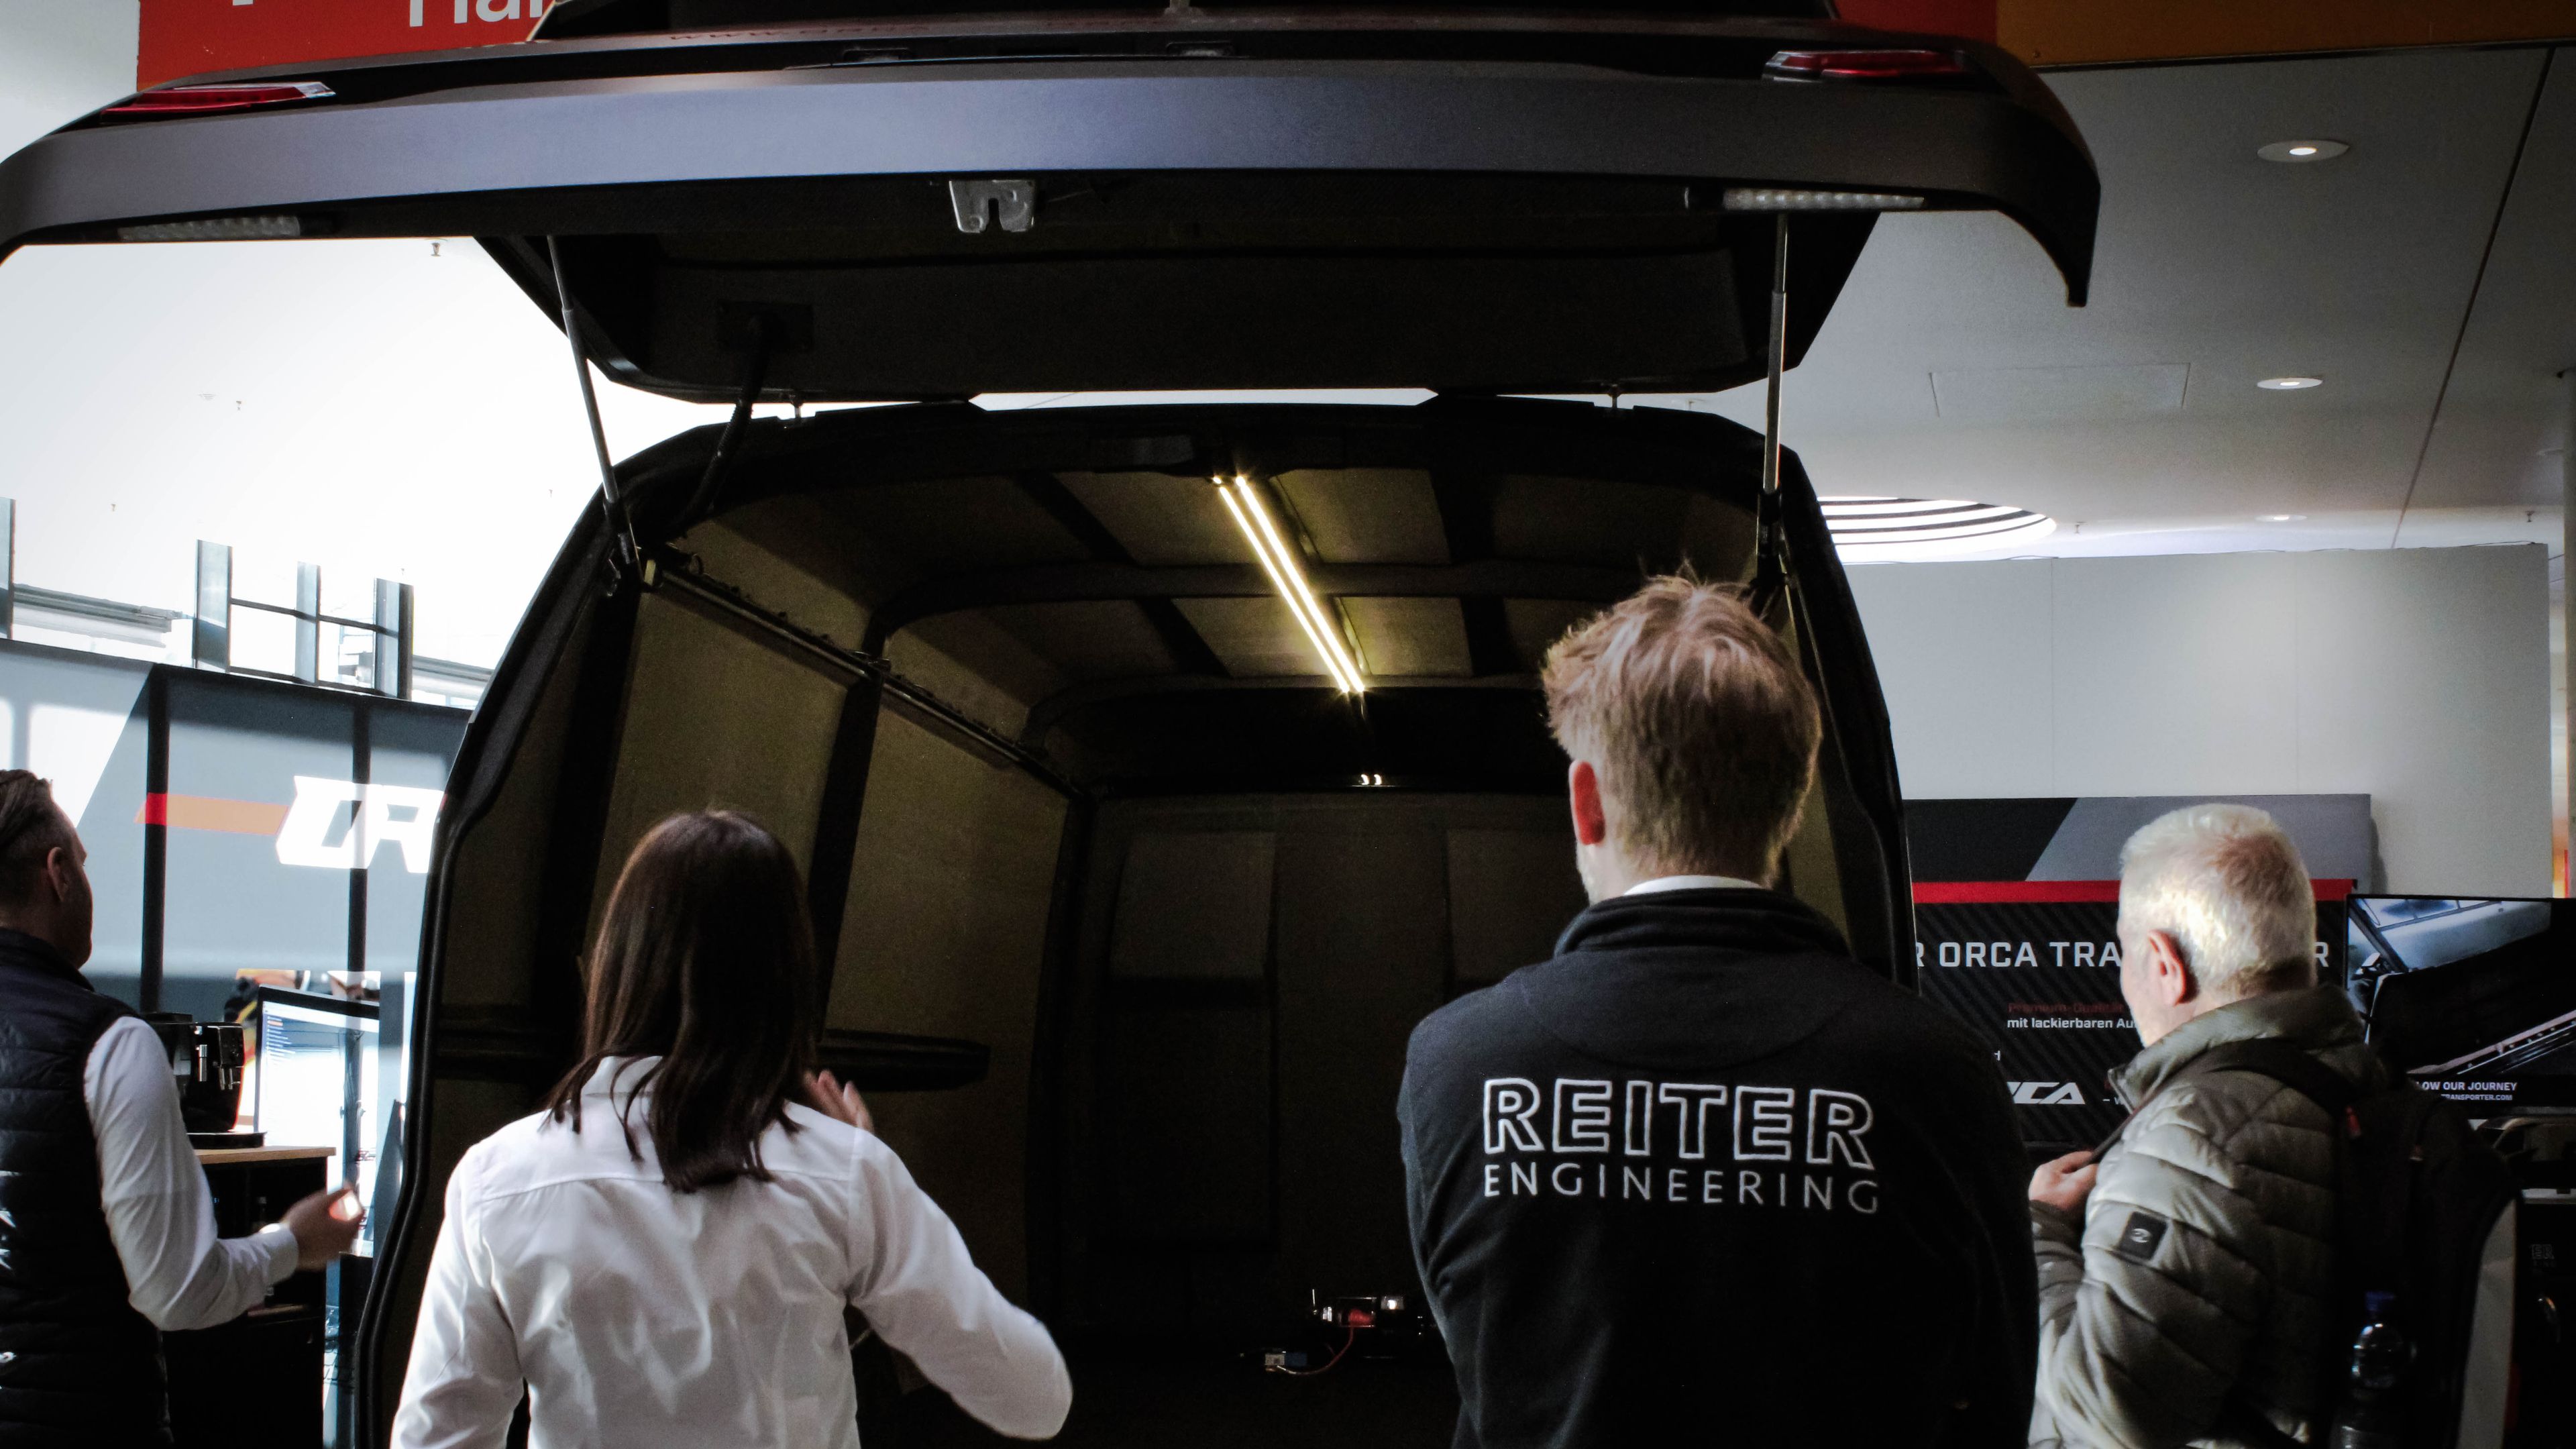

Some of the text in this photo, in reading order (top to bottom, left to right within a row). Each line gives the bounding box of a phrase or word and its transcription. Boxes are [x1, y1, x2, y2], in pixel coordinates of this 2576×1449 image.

[1939, 941, 2039, 967] ORCA
[2007, 1018, 2029, 1028] mit
[2032, 1018, 2112, 1028] lackierbaren
[2443, 1081, 2465, 1091] OUR
[2467, 1081, 2518, 1091] JOURNEY
[1483, 1077, 1875, 1171] REITER
[1484, 1162, 1878, 1215] ENGINEERING
